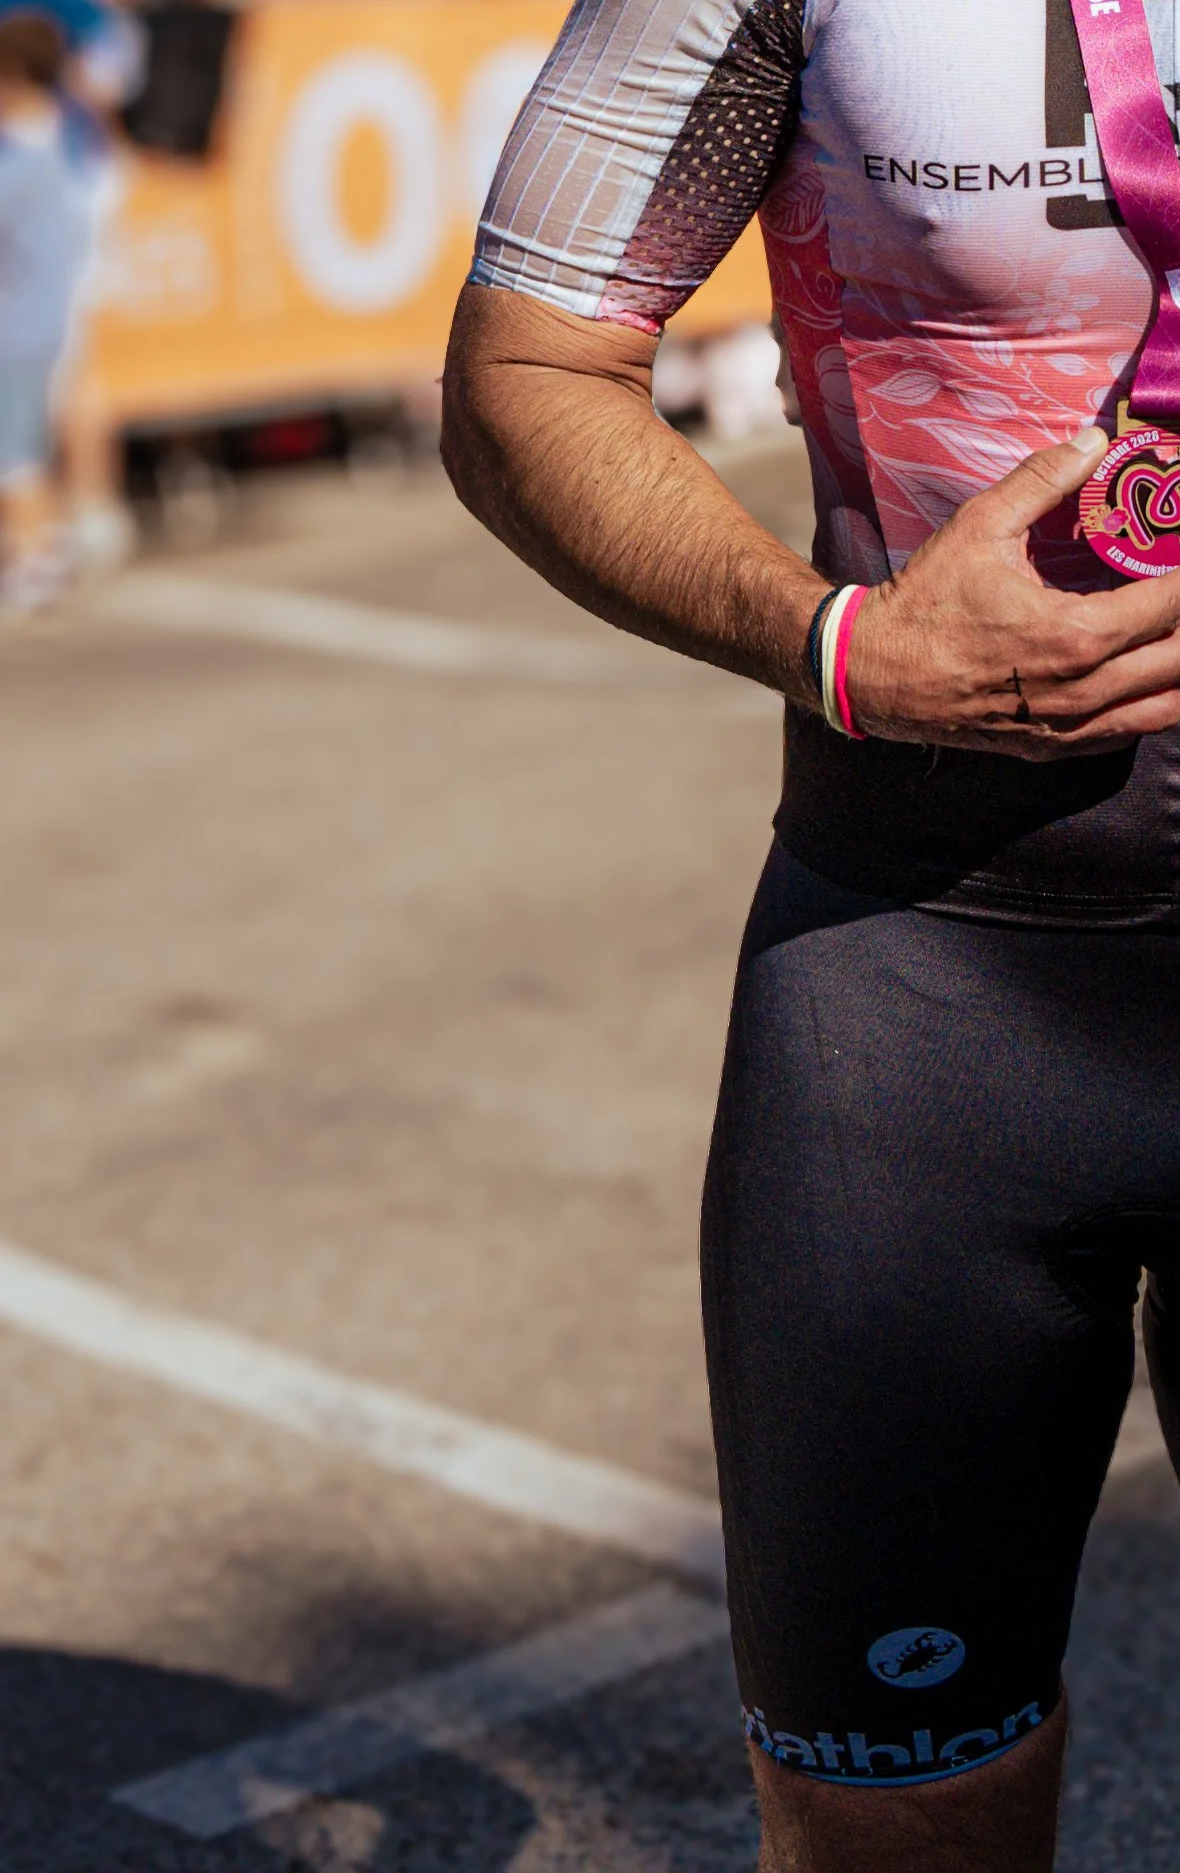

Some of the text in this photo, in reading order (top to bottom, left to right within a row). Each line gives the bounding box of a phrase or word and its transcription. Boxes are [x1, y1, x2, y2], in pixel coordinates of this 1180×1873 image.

[863, 154, 1106, 191] ENSEMBL
[1092, 440, 1133, 482] OCTOBRE
[1106, 545, 1126, 564] LES
